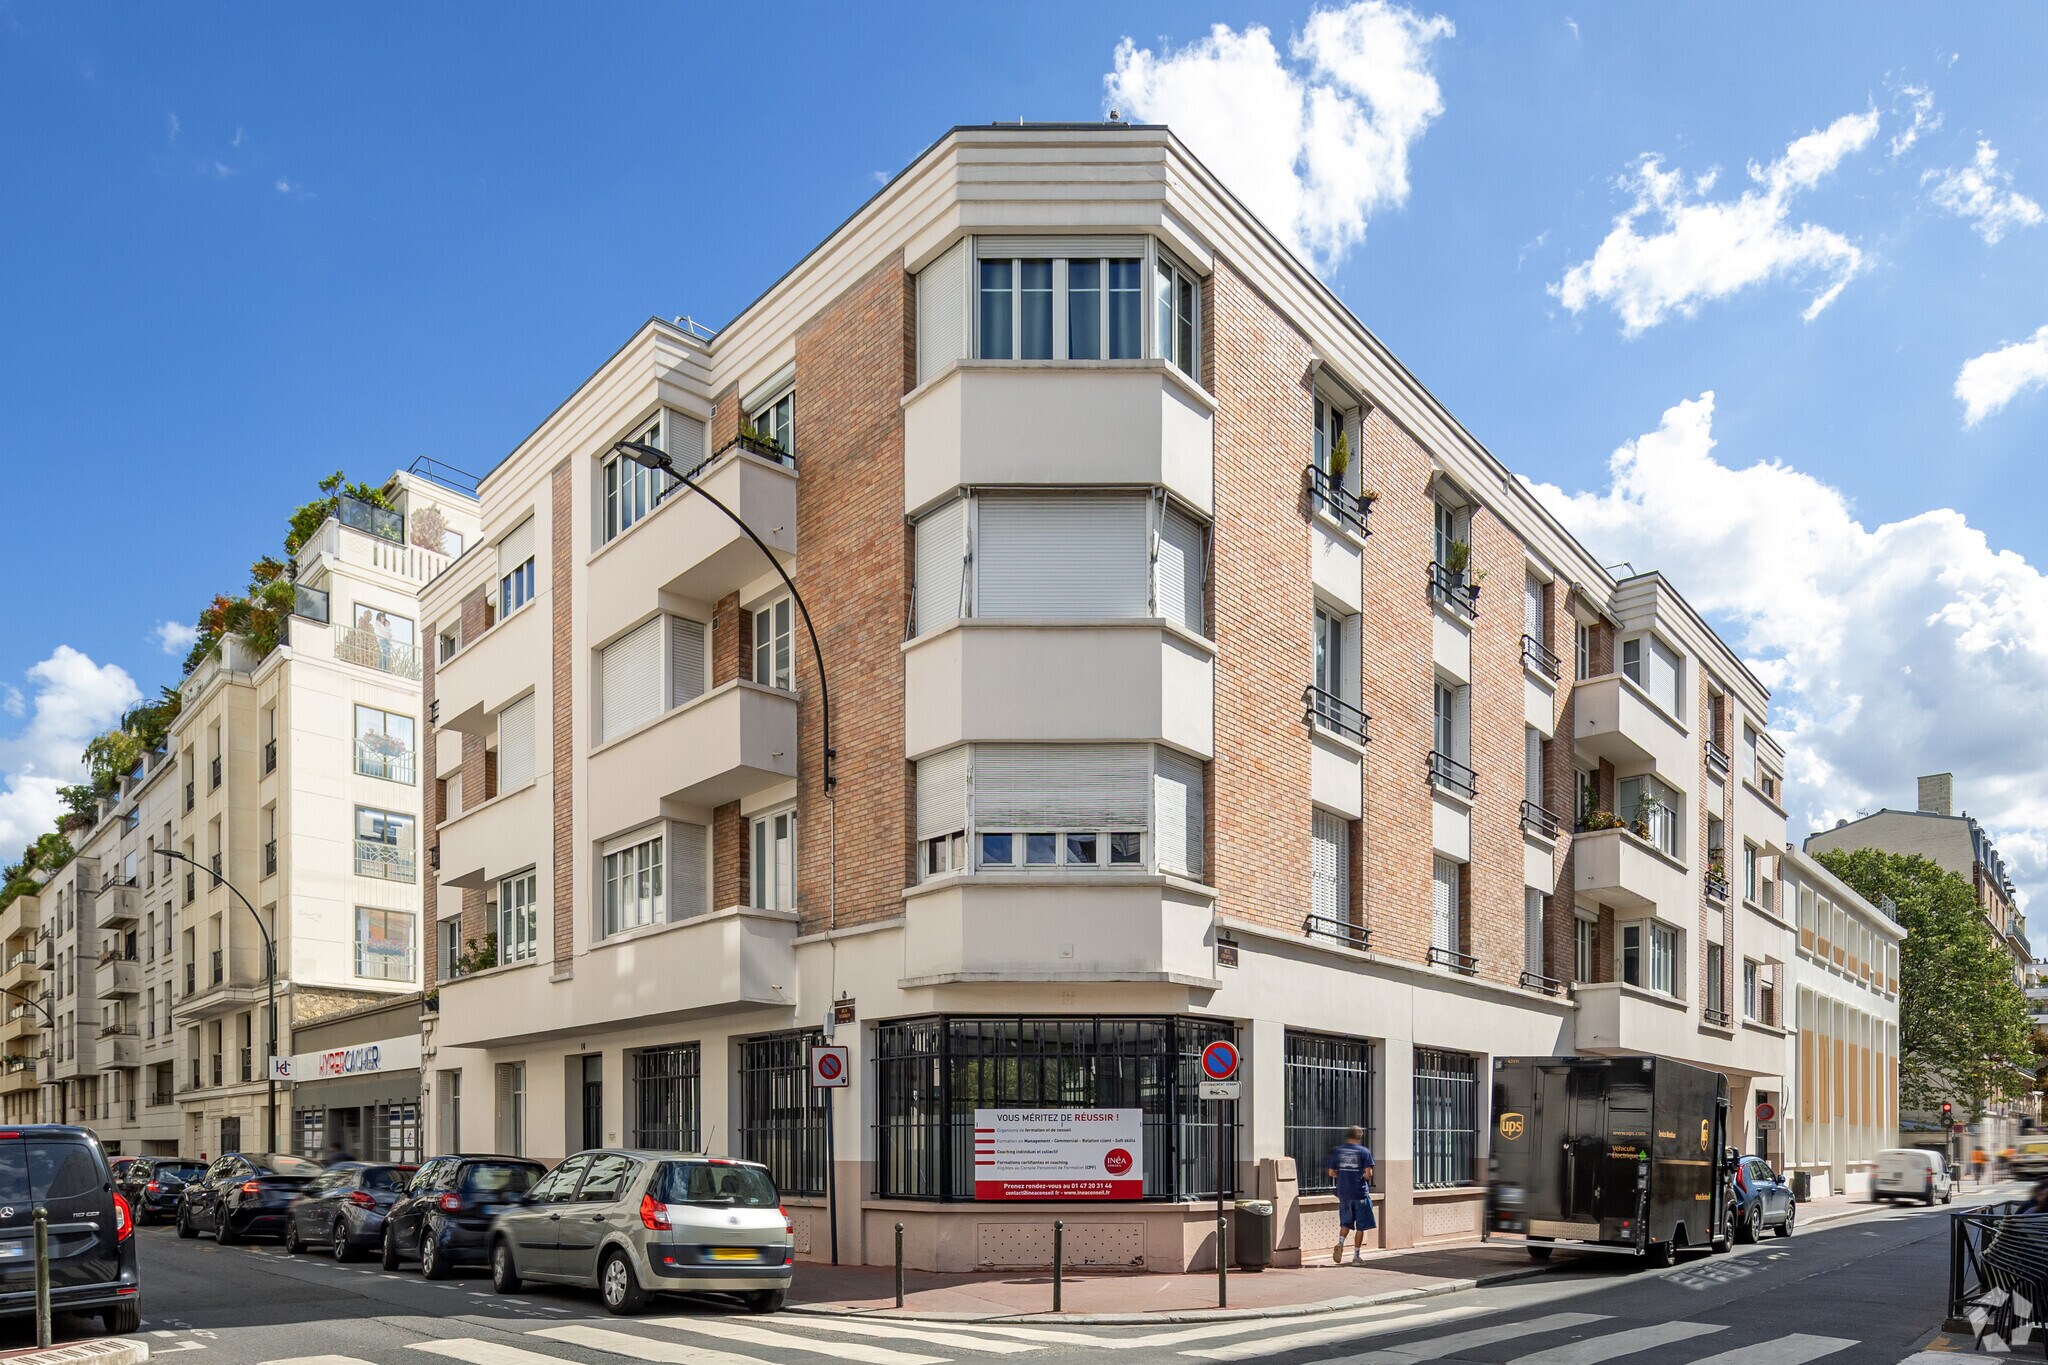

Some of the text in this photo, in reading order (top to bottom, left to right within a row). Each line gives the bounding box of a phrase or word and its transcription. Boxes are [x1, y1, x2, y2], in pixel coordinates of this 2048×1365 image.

[997, 1114, 1020, 1122] VOUS
[1022, 1113, 1058, 1122] MÉRITEZ
[1074, 1112, 1113, 1121] RÉUSSIR
[1502, 1121, 1522, 1136] ups
